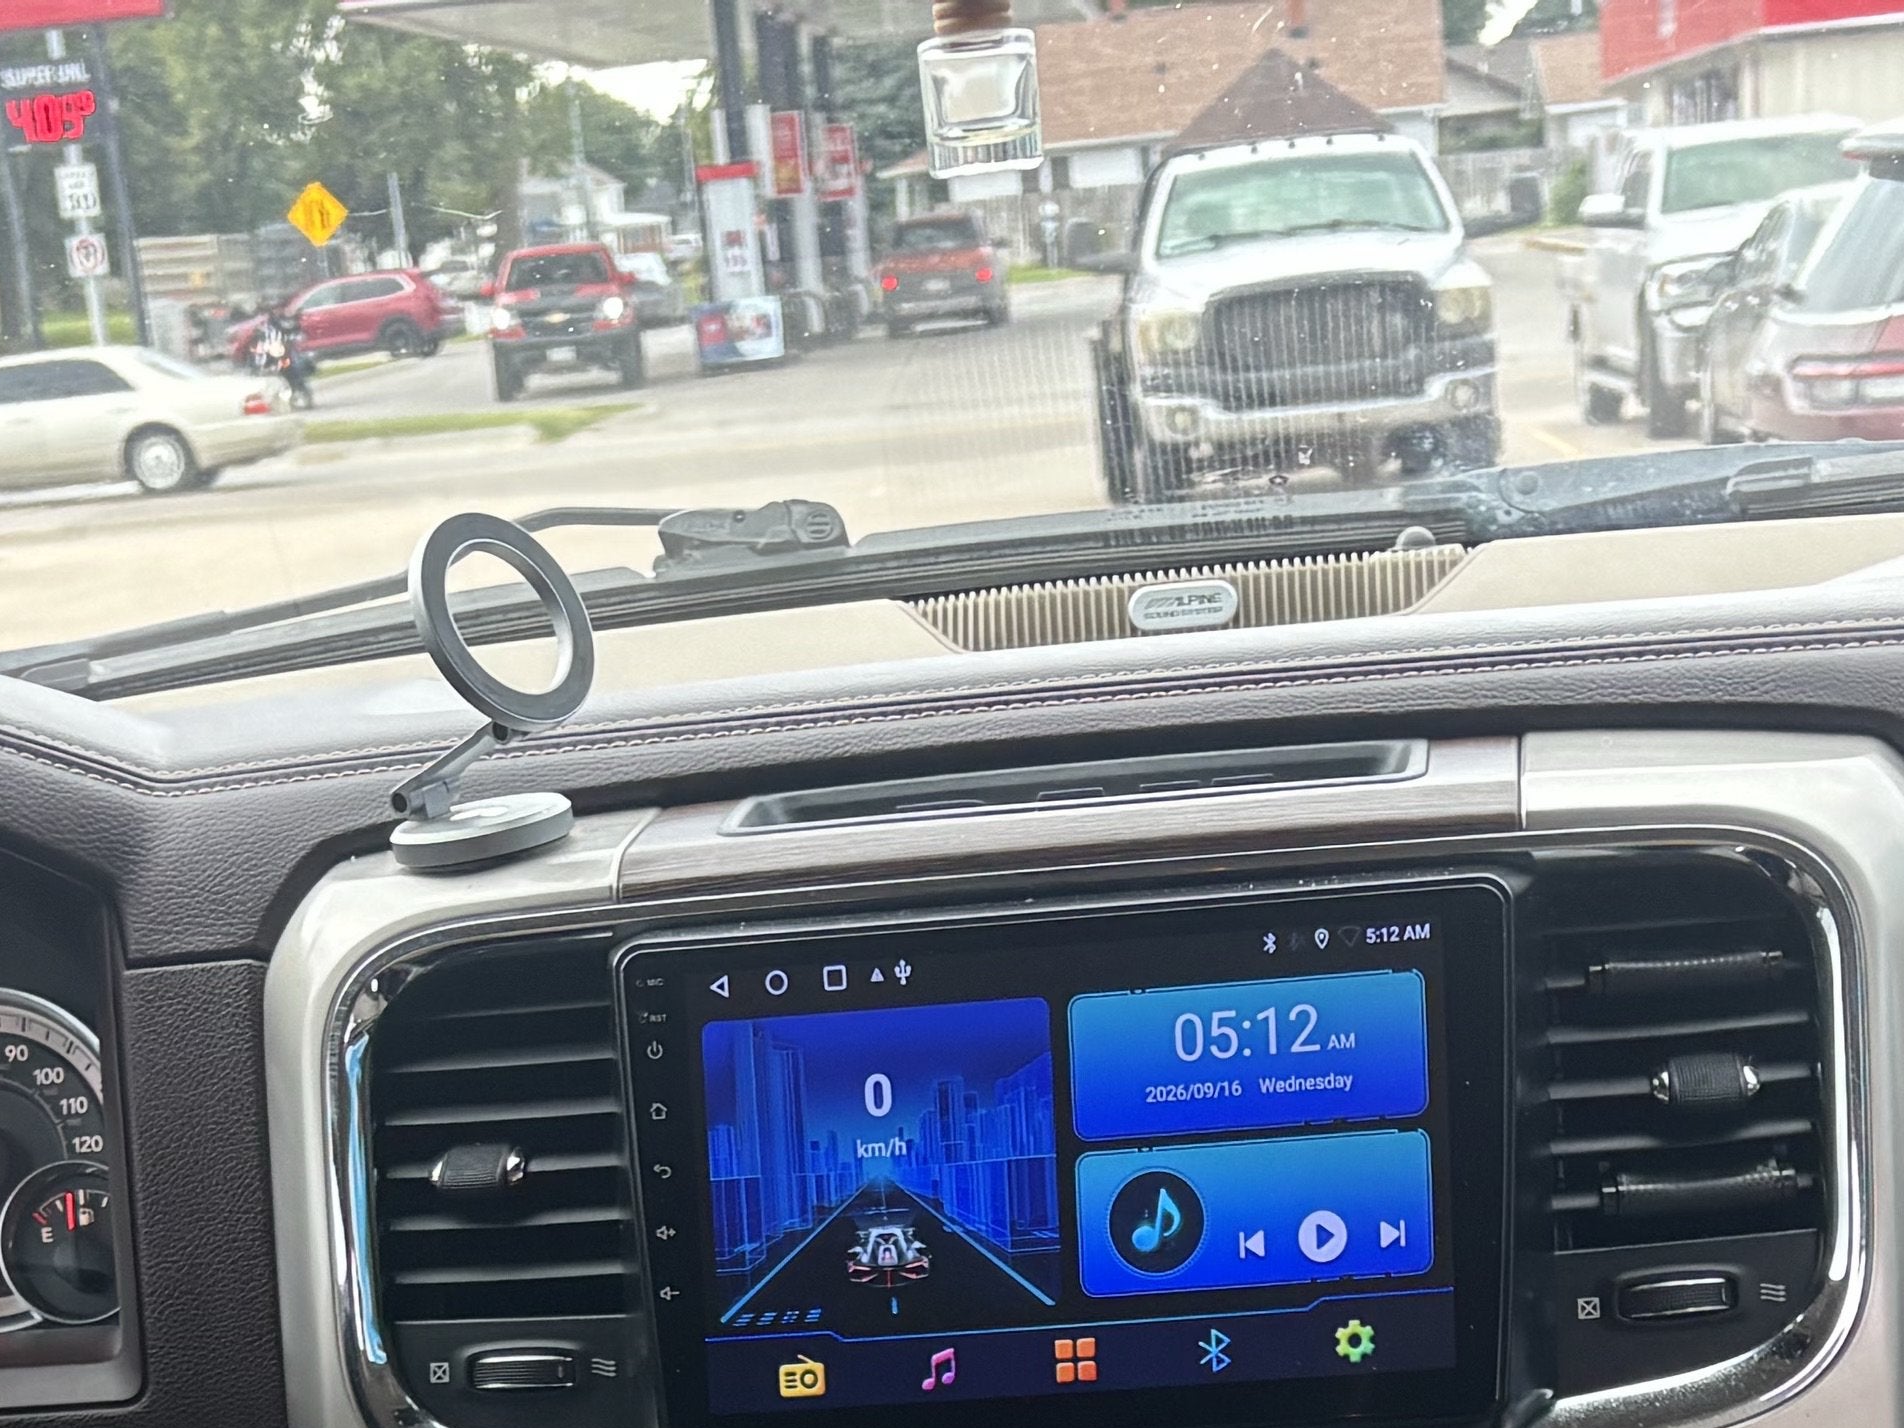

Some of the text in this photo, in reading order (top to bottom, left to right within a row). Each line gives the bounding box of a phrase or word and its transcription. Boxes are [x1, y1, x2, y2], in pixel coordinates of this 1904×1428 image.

[1366, 923, 1431, 944] 5:12 AM
[1174, 1004, 1356, 1062] 05:12 AM
[5, 1044, 29, 1063] 90
[32, 1067, 64, 1085] 100
[864, 1073, 892, 1117] 0
[1145, 1073, 1353, 1103] 2026/09/16 Wednesday
[59, 1096, 88, 1114] 110
[72, 1135, 104, 1153] 120
[856, 1138, 907, 1160] km/h
[41, 1227, 54, 1243] E
